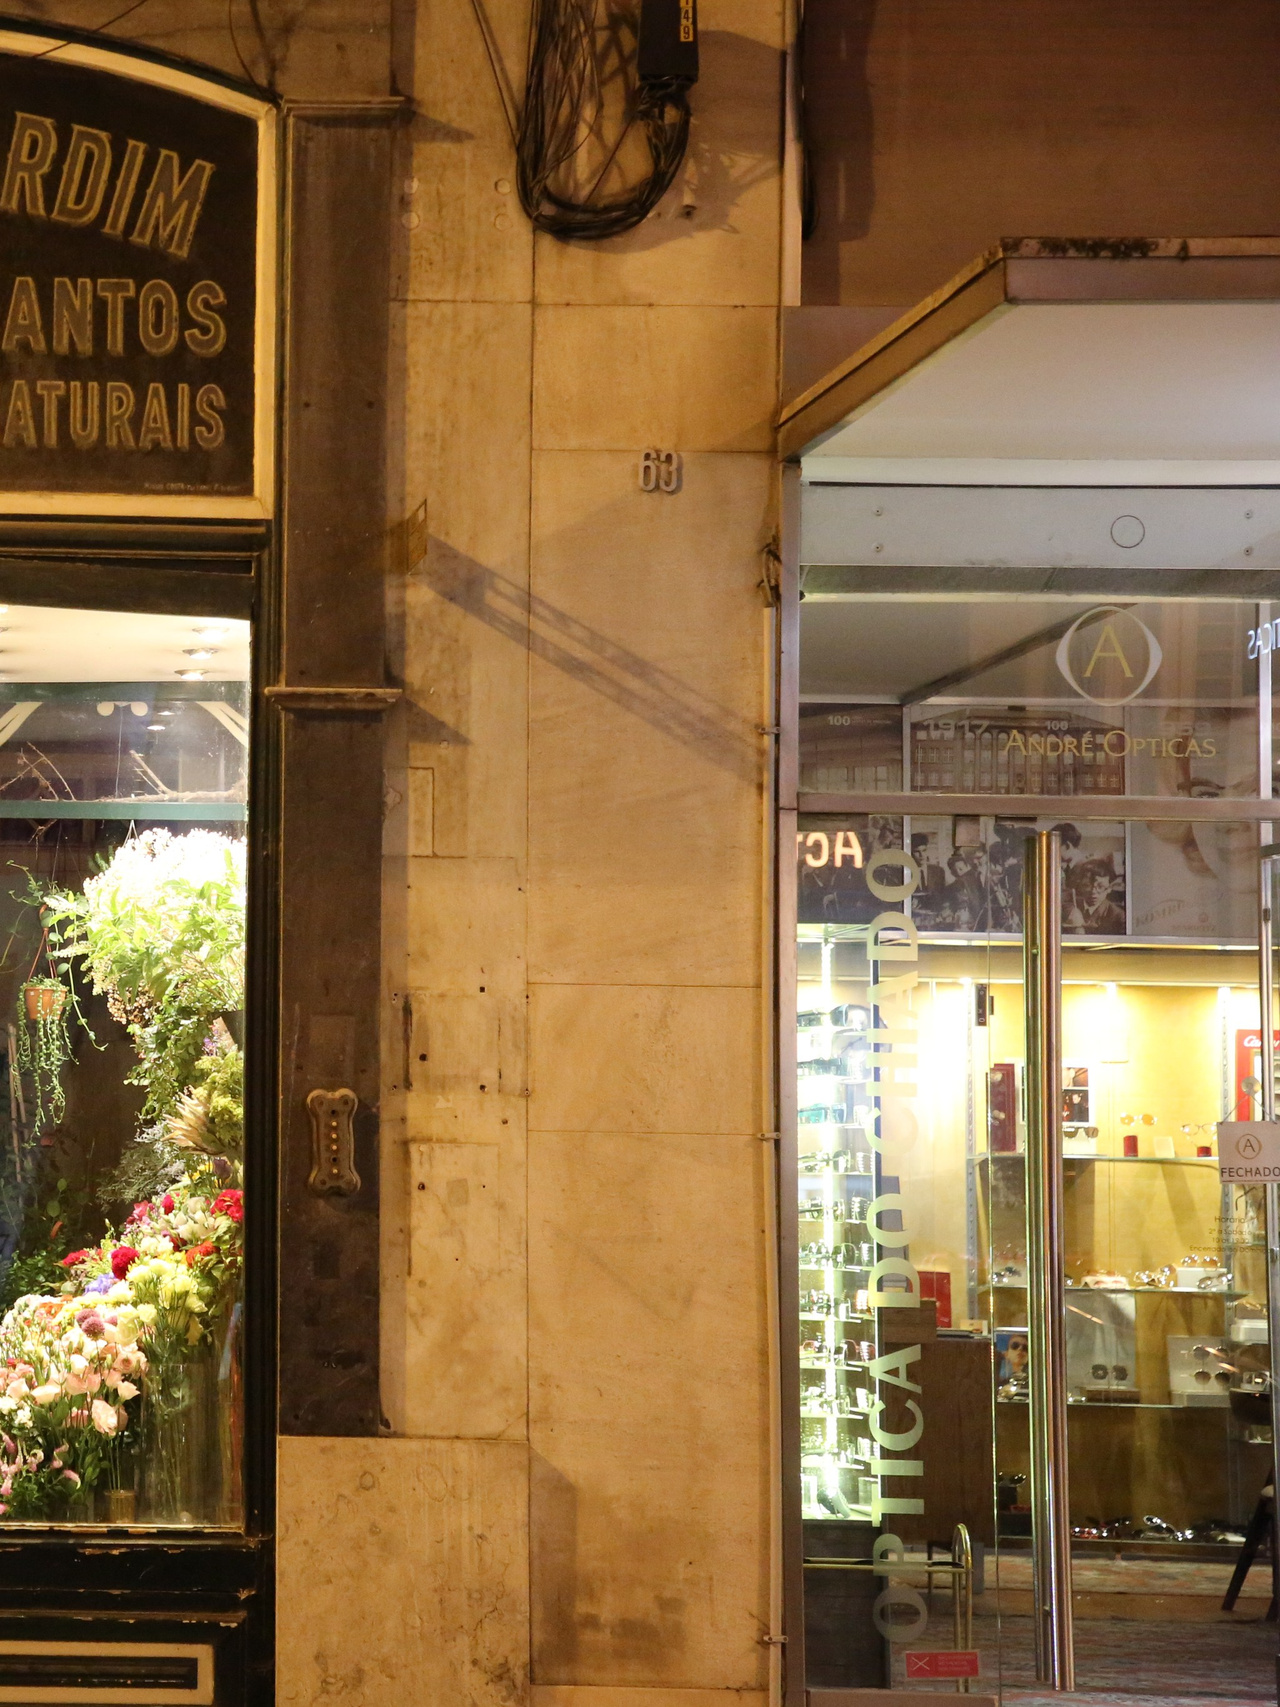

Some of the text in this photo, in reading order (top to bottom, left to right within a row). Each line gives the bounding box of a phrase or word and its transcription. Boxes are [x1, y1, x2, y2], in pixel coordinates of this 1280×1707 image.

[638, 450, 678, 491] 63
[827, 715, 851, 726] 100
[922, 719, 990, 736] 1917
[1004, 729, 1217, 758] ANDRÉ OPTICAS
[1220, 1166, 1280, 1178] FECHADO
[866, 848, 927, 1643] OPTICA DO CHIADO
